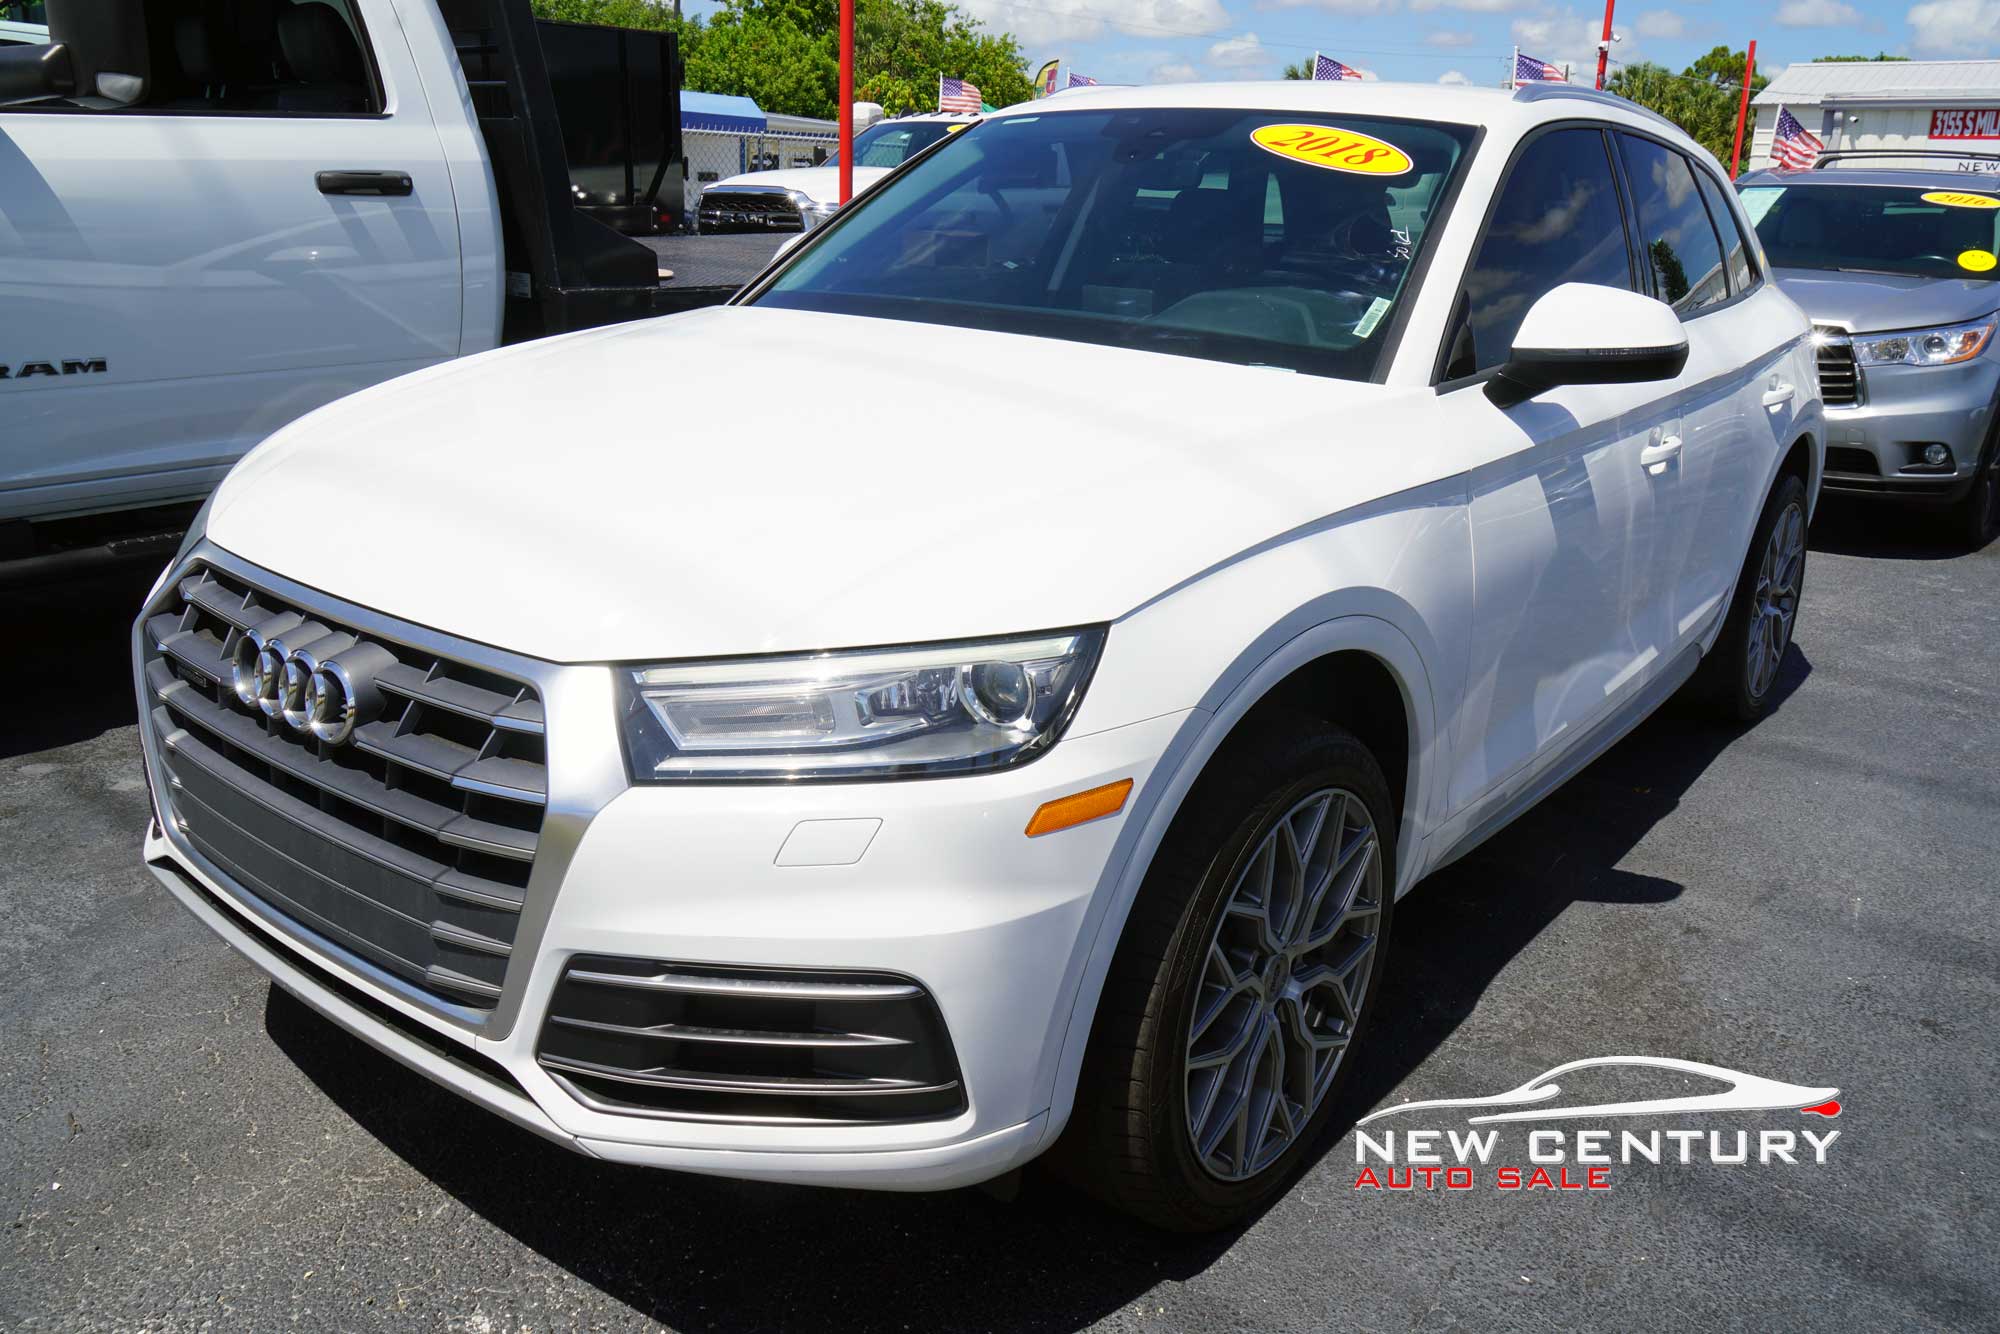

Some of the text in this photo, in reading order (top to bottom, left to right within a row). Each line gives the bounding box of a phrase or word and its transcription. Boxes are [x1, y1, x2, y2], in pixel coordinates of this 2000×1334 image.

[1933, 111, 1965, 136] 3155
[1963, 111, 1975, 136] S
[1267, 130, 1391, 165] 2018
[1958, 161, 2000, 172] NEW
